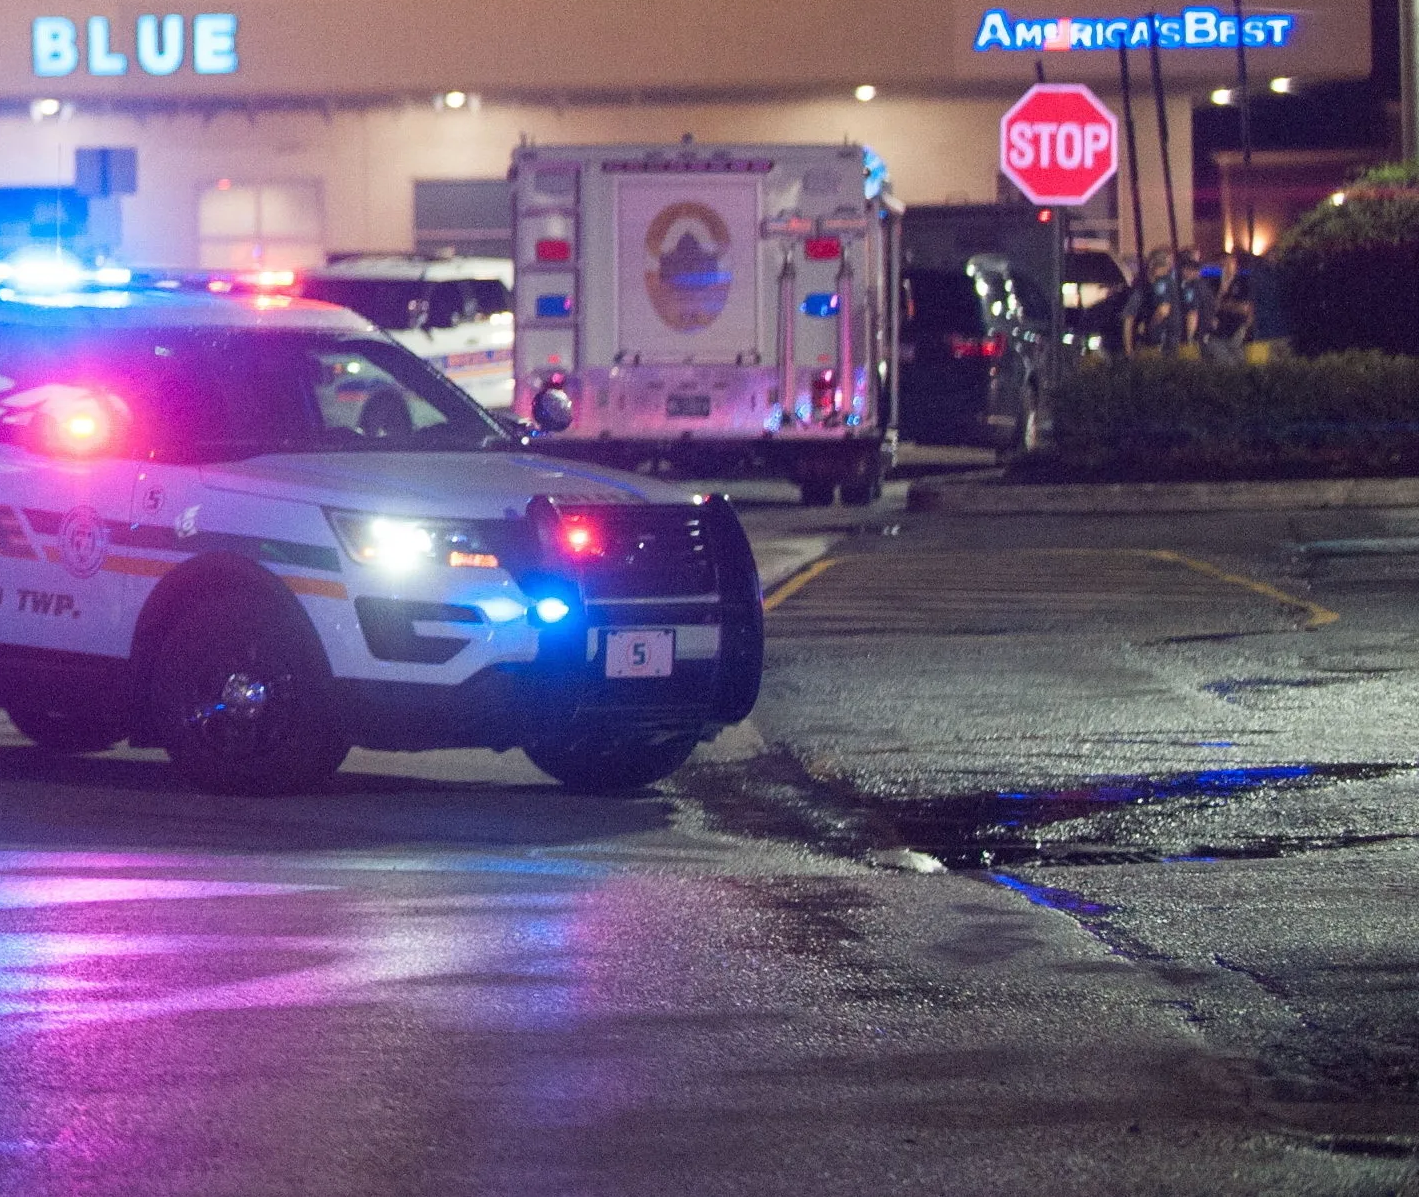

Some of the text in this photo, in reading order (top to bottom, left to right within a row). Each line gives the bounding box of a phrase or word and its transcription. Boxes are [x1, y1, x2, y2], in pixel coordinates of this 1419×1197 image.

[32, 13, 238, 76] BLUE
[1009, 121, 1109, 170] STOP
[16, 588, 82, 619] TWP.
[632, 643, 646, 665] 5
